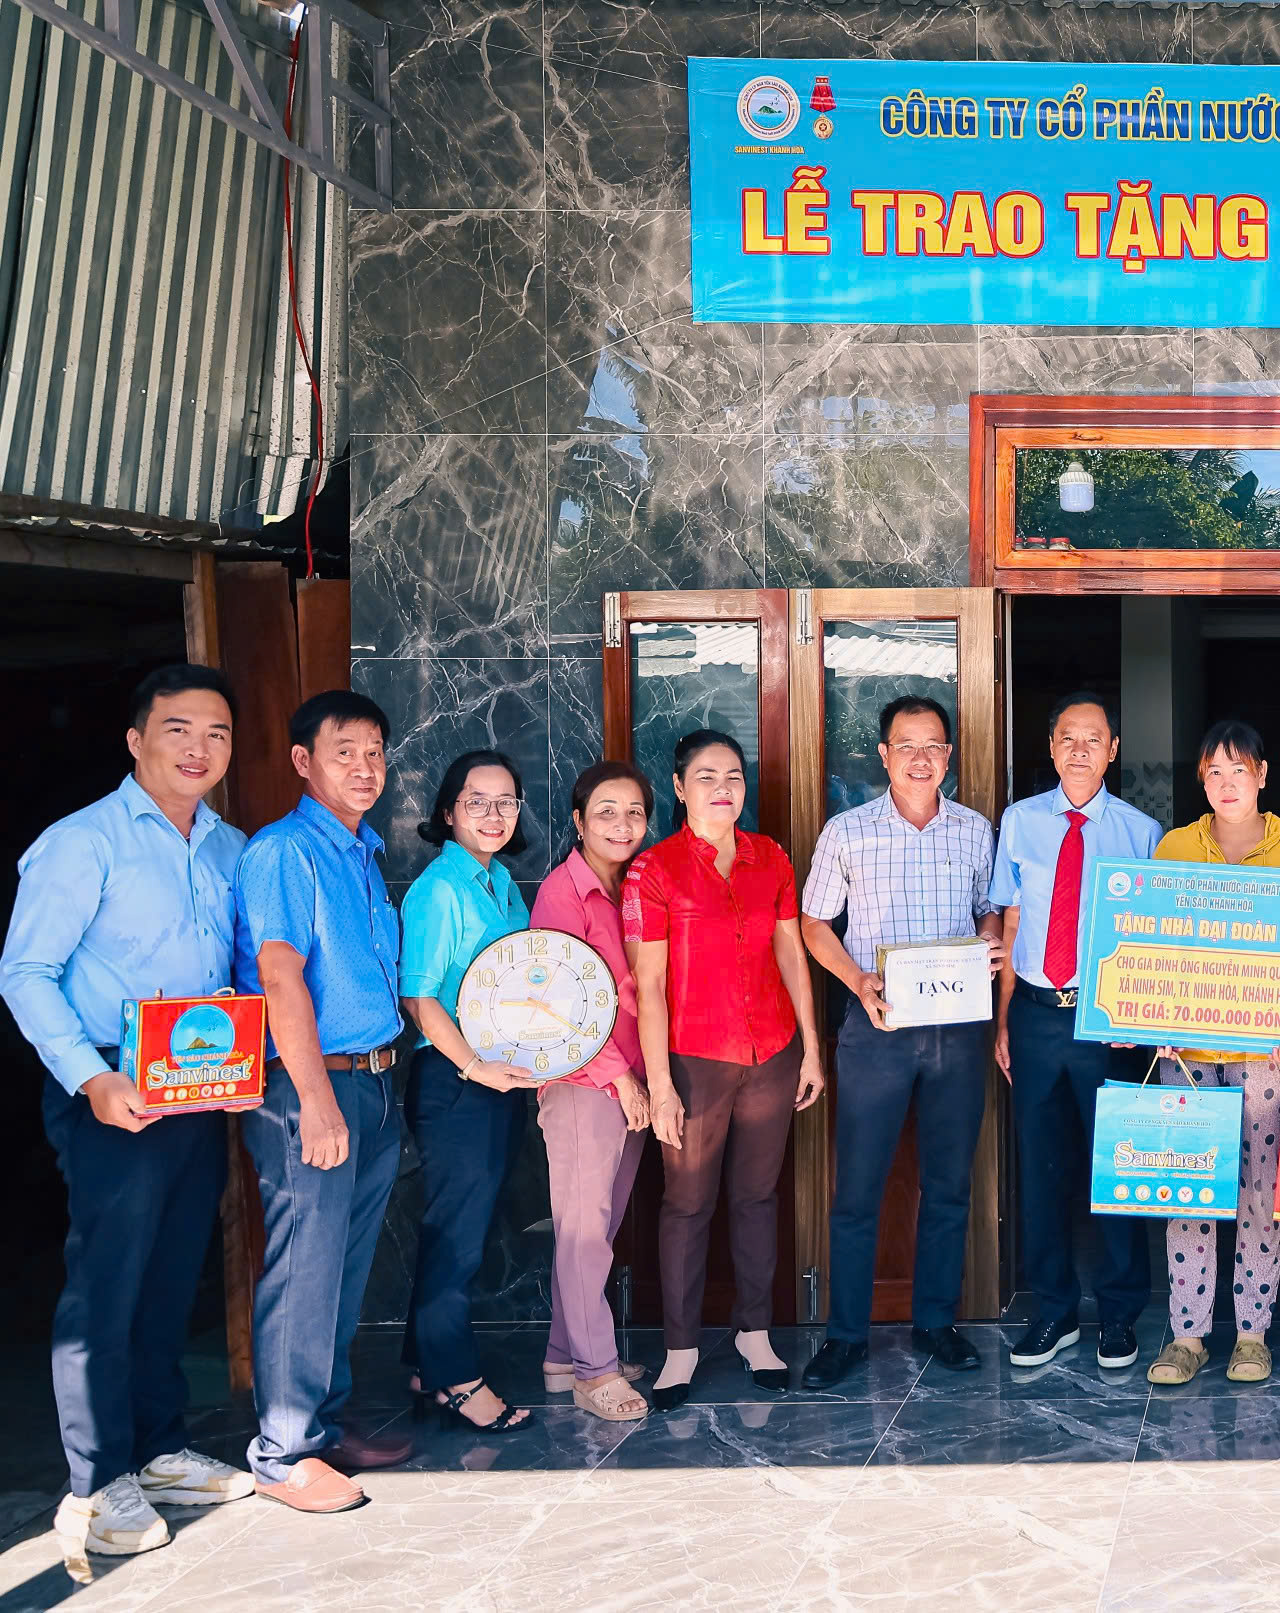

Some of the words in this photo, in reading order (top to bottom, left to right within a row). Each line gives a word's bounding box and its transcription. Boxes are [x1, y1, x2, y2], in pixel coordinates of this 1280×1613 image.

[881, 89, 978, 138] CÔNG
[984, 98, 1029, 138] TY
[1036, 84, 1087, 140] CỔ
[1094, 87, 1192, 141] PHẦN
[741, 165, 831, 256] LỄ
[851, 189, 1045, 259] TRAO
[1065, 179, 1270, 273] TẶNG
[1151, 874, 1173, 889] CÔNG
[1174, 878, 1184, 890] TY
[1113, 911, 1156, 936] TẶNG
[1160, 915, 1194, 937] NHÀ
[1197, 919, 1227, 943] ĐẠI
[1231, 919, 1277, 943] ĐOÀN
[494, 944, 514, 963] 11
[524, 936, 548, 956] 12
[562, 942, 571, 960] 1
[582, 962, 596, 979] 2
[1117, 956, 1135, 969] CHO
[1137, 957, 1152, 971] GIA
[1155, 956, 1178, 973] ĐÌNH
[1180, 958, 1200, 974] ÔNG
[1241, 964, 1267, 979] MINH
[473, 968, 496, 988] 10
[916, 979, 964, 997] TẶNG
[595, 989, 609, 1009] 3
[1119, 974, 1130, 994] XÃ
[1132, 977, 1155, 995] NINH
[1157, 979, 1176, 999] SIM,
[1179, 981, 1190, 998] TX
[1193, 982, 1217, 1000] NINH
[1219, 981, 1240, 1003] HÒA,
[1242, 983, 1274, 1004] KHÁNH
[468, 999, 482, 1019] 9
[1117, 1001, 1139, 1023] TRỊ
[1142, 1000, 1170, 1020] GIÁ:
[1173, 1005, 1251, 1026] 70.000.000
[480, 1030, 494, 1049] 8
[584, 1021, 600, 1040] 4
[535, 1052, 549, 1072] 6
[567, 1044, 582, 1062] 5
[147, 1056, 253, 1091] Sanvinest
[1114, 1139, 1217, 1170] Sanvinest
